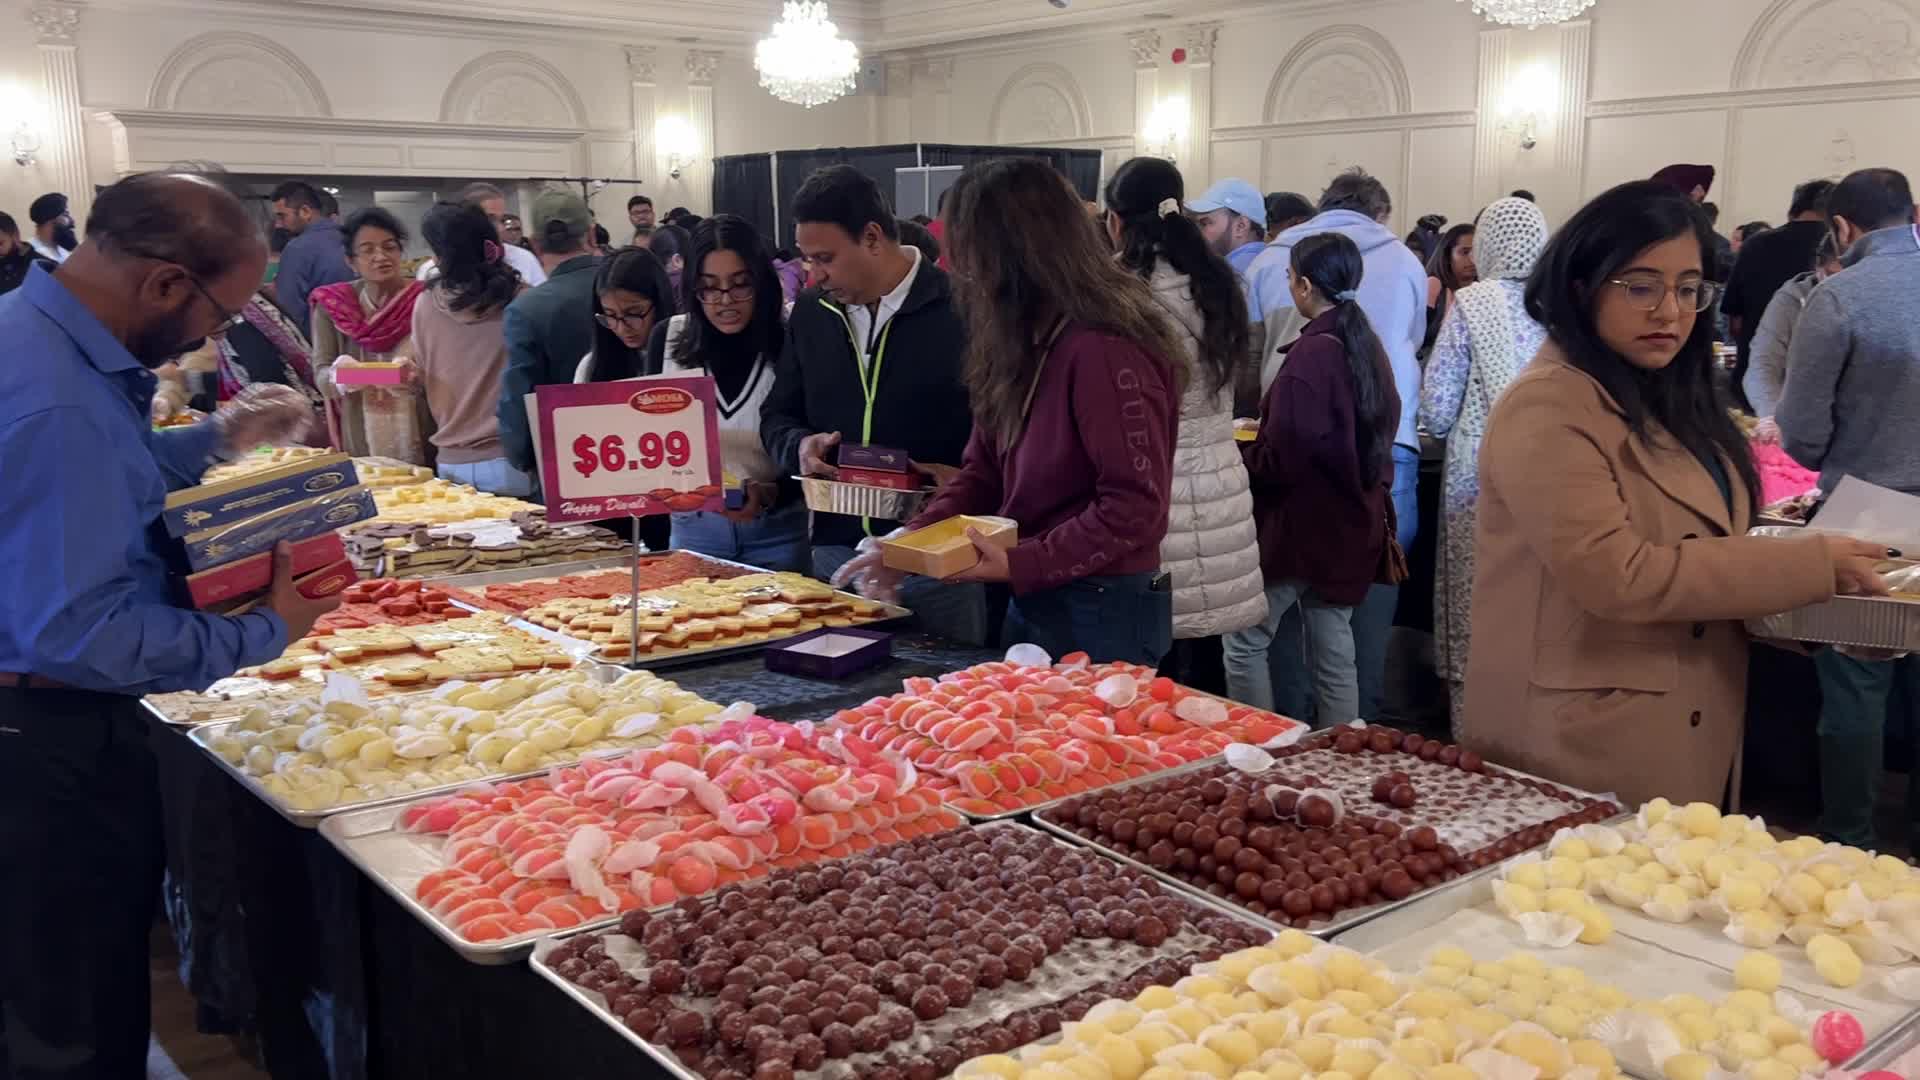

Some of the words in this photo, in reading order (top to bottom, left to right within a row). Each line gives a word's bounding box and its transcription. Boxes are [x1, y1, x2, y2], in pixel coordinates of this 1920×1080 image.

[573, 430, 690, 478] $6.99
[560, 502, 602, 516] Happy
[604, 496, 648, 513] Diwali
